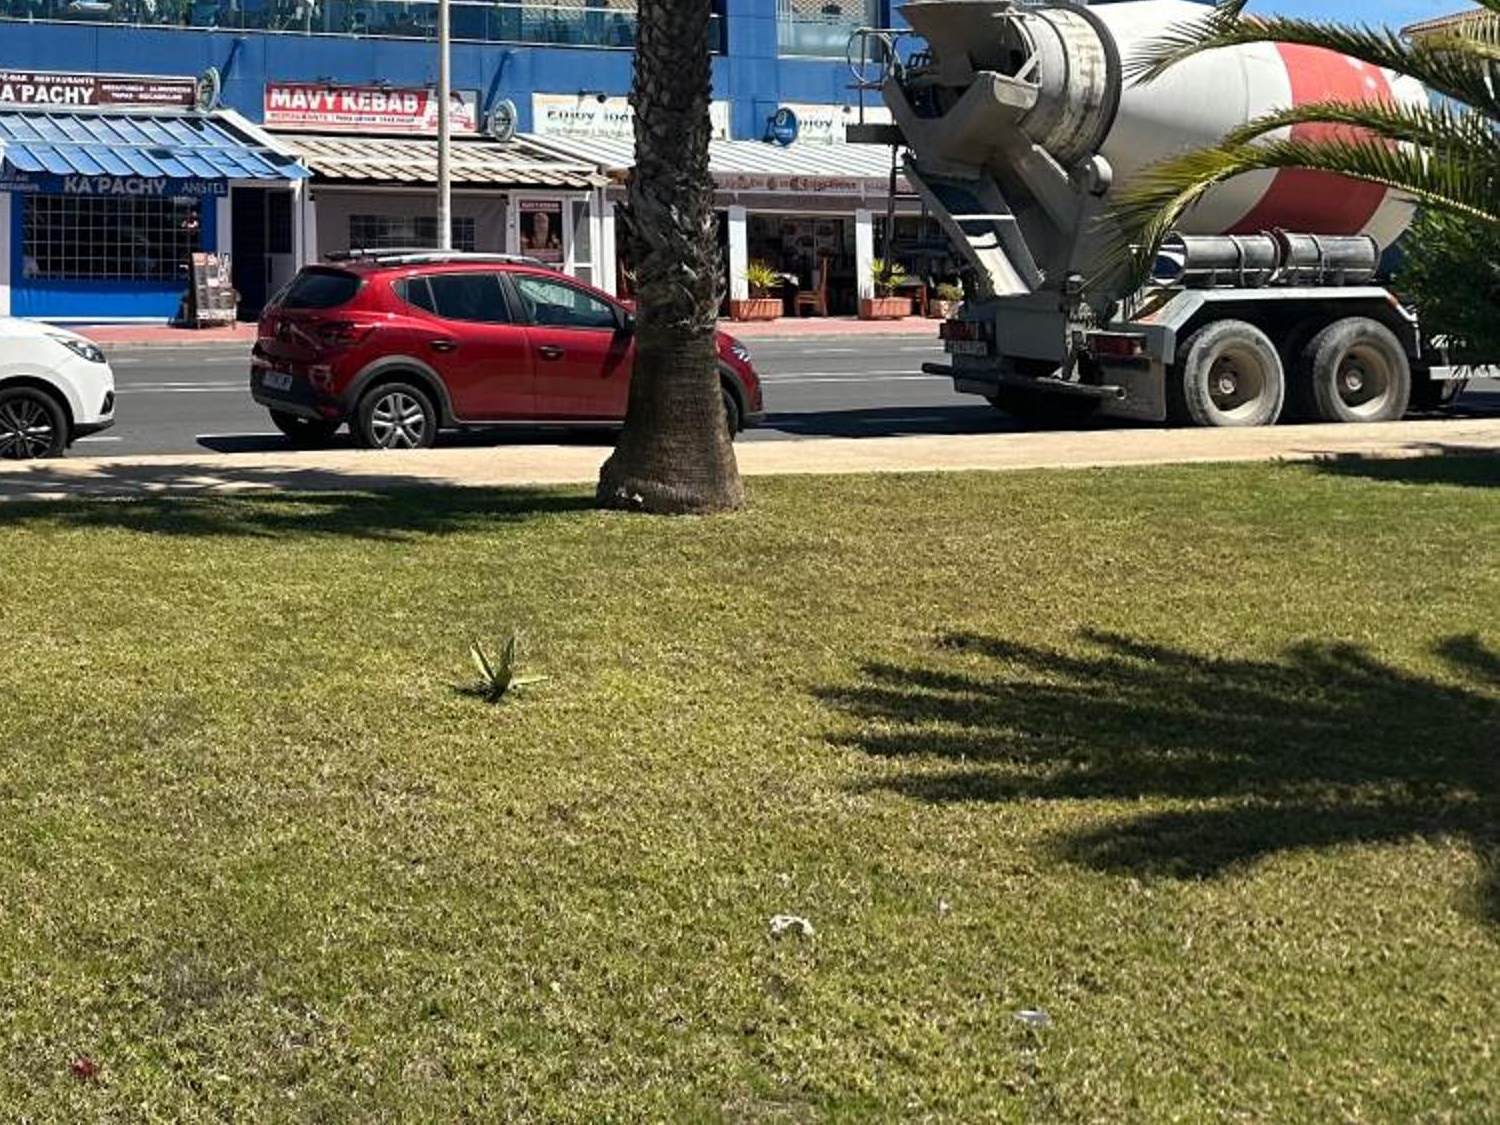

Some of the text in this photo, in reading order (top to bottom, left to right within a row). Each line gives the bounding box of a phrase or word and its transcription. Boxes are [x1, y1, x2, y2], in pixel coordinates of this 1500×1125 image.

[270, 88, 420, 114] MAVY KEBAB
[798, 114, 833, 133] njoy
